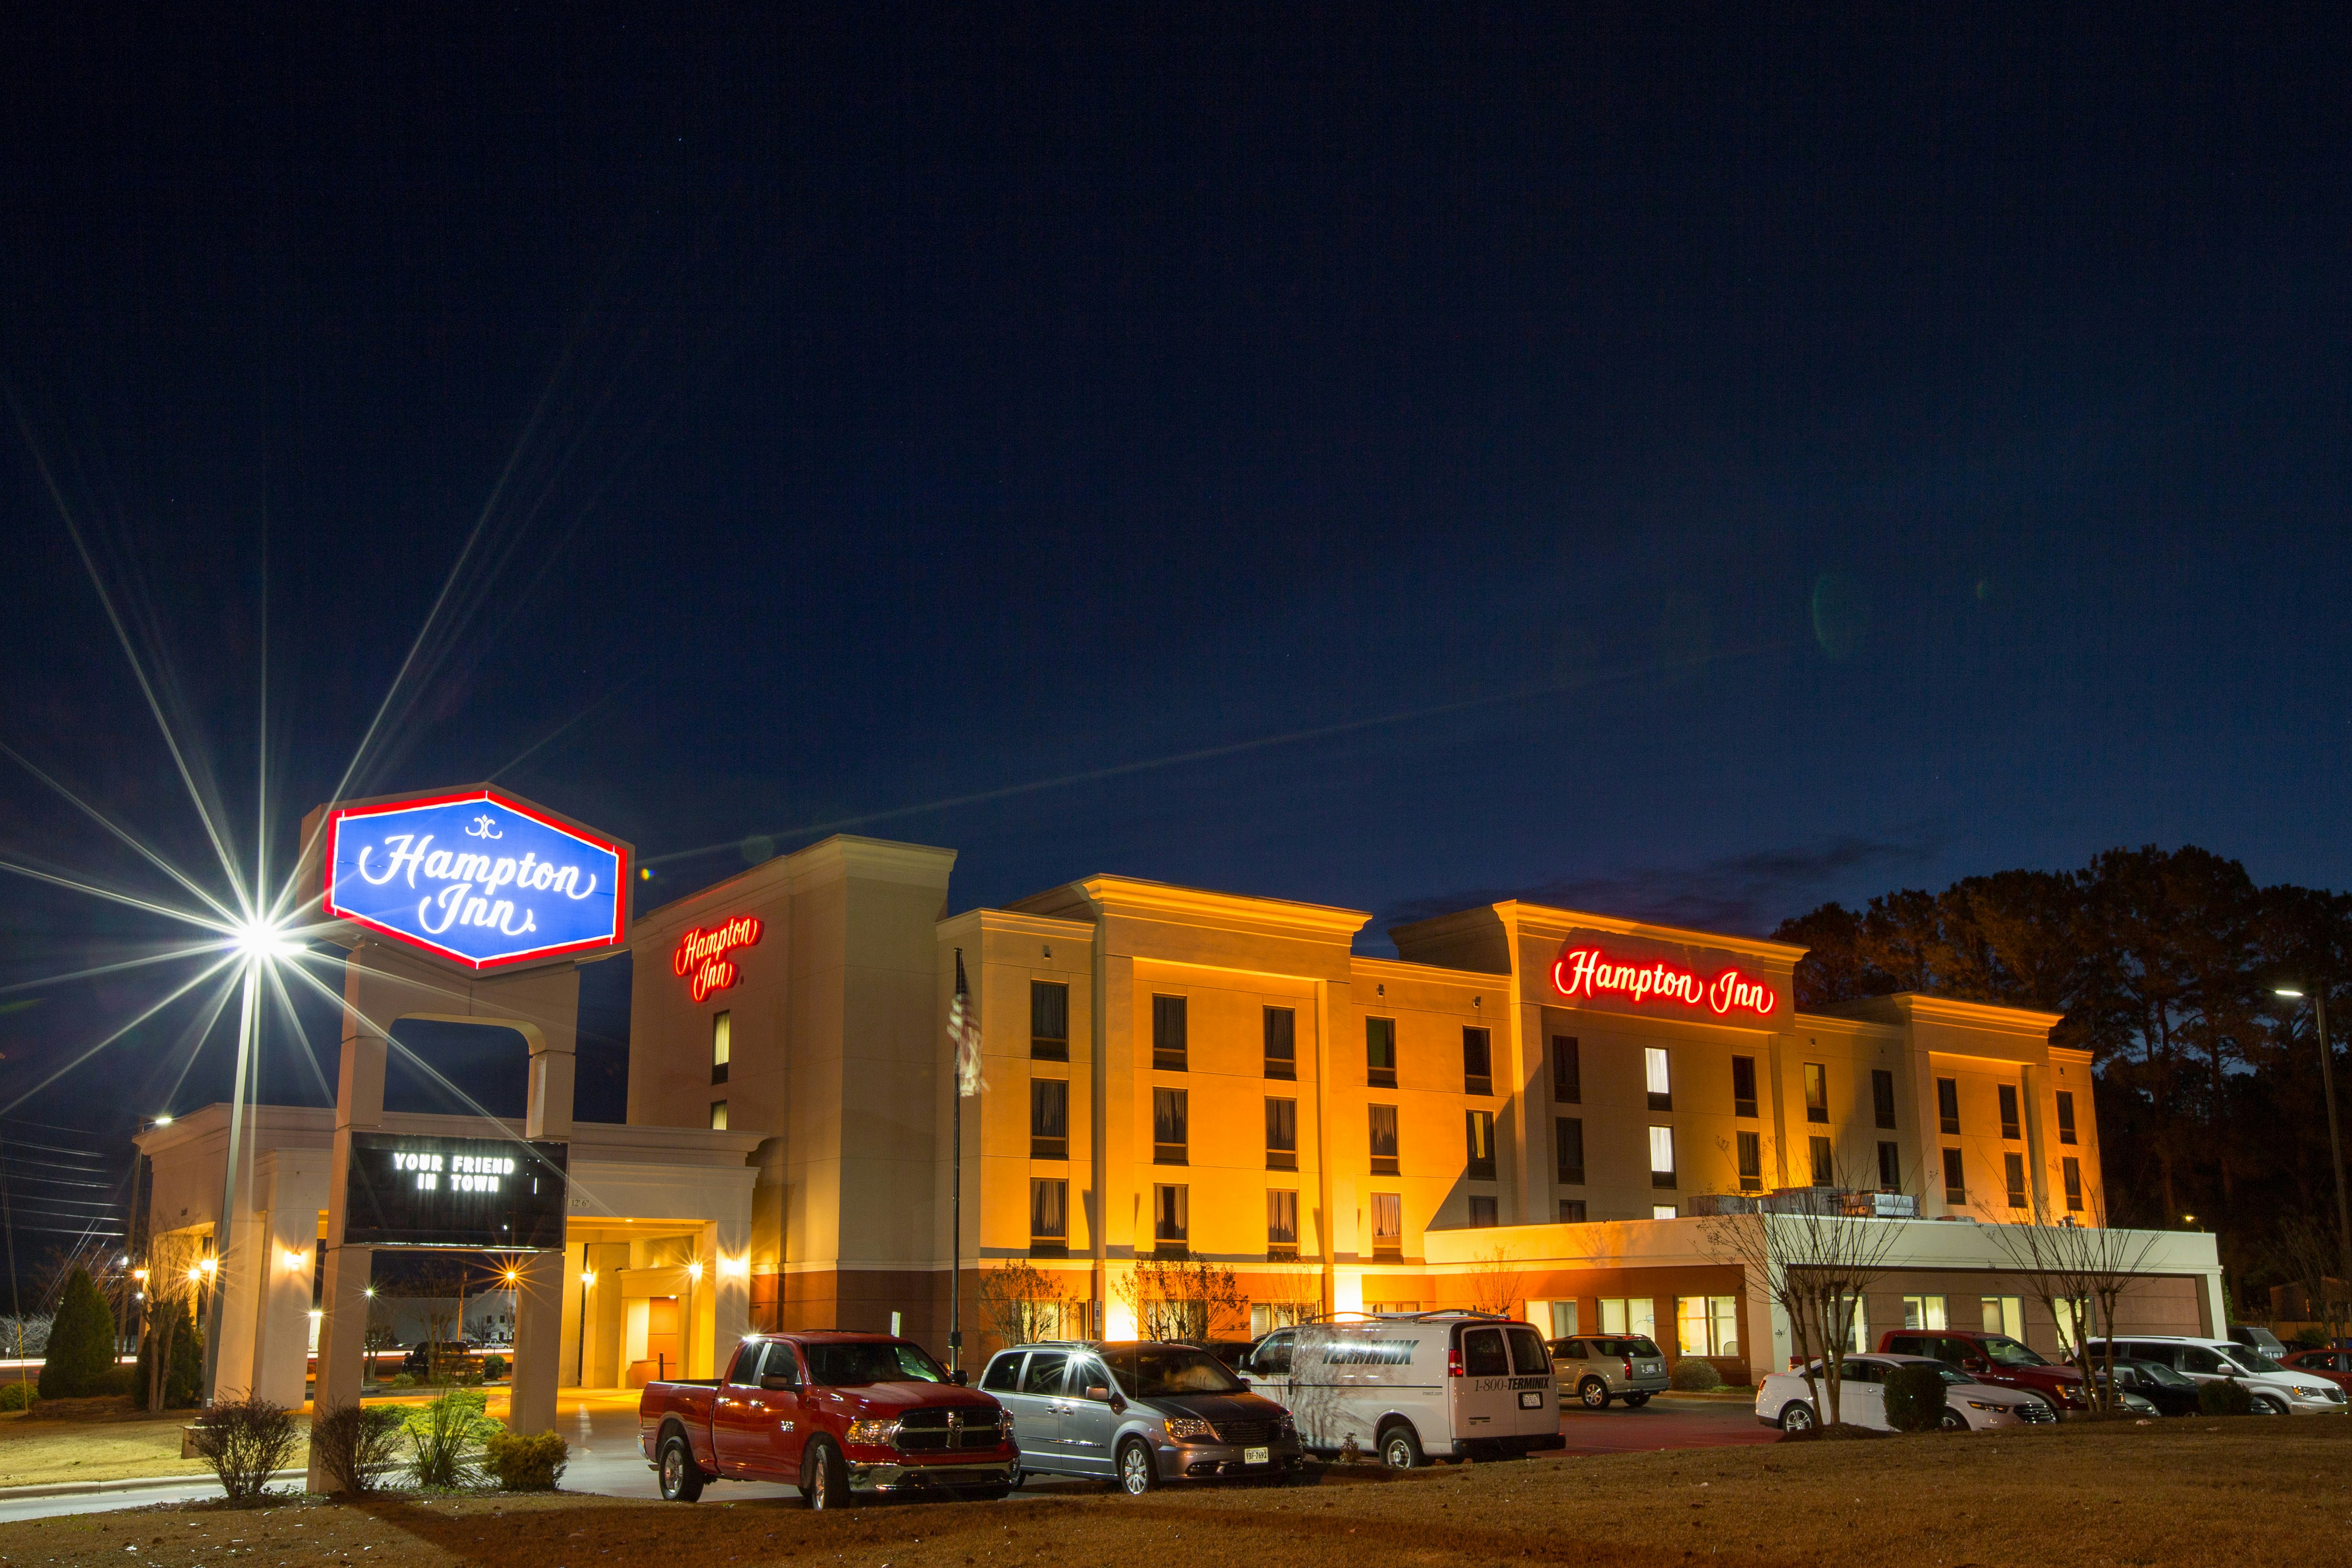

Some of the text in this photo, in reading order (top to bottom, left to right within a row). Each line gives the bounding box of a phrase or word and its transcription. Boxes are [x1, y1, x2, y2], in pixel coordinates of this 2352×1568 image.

[359, 834, 596, 899] Hampton
[675, 918, 757, 975] Hampton
[693, 957, 732, 1001] Inn
[1555, 950, 1774, 1013] Hampton Inn
[394, 1153, 514, 1175] YOUR FRIEND
[417, 1173, 499, 1192] IN TOWN
[1322, 1339, 1420, 1365] TERMINIX
[1475, 1377, 1550, 1392] 1-800-TERMINIX
